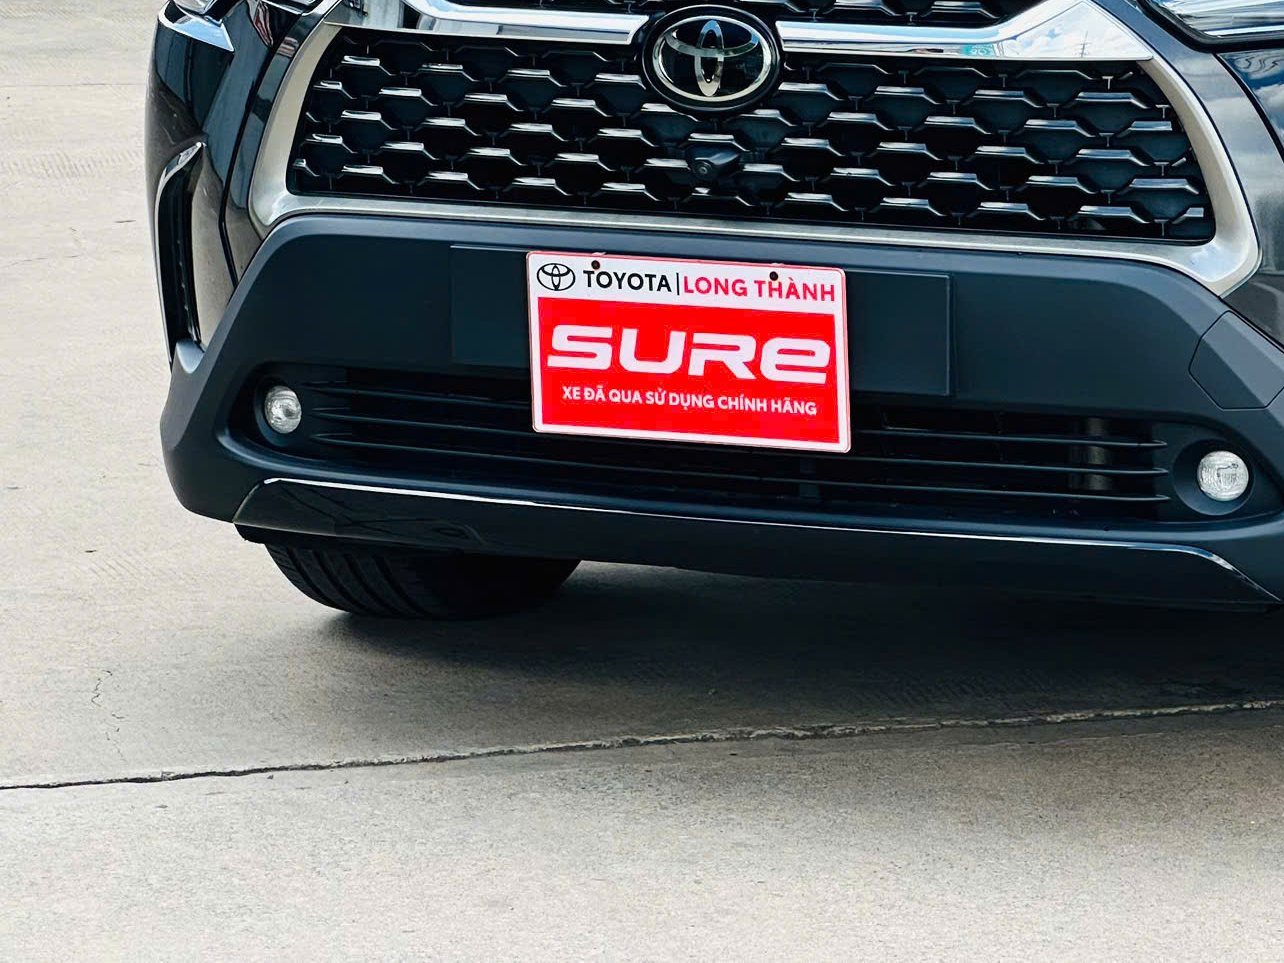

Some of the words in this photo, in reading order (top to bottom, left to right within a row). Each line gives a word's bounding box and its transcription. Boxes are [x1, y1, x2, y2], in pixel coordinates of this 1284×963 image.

[583, 269, 673, 293] TOYOTA
[683, 276, 749, 299] LONG
[755, 275, 836, 303] THÀNH
[562, 386, 581, 401] XE
[584, 385, 605, 402] ĐÃ
[608, 389, 643, 405] QUA
[646, 388, 666, 406] SỬ
[668, 393, 715, 411] DỤNG
[717, 394, 768, 413] CHÍNH
[771, 397, 818, 416] HÃNG
